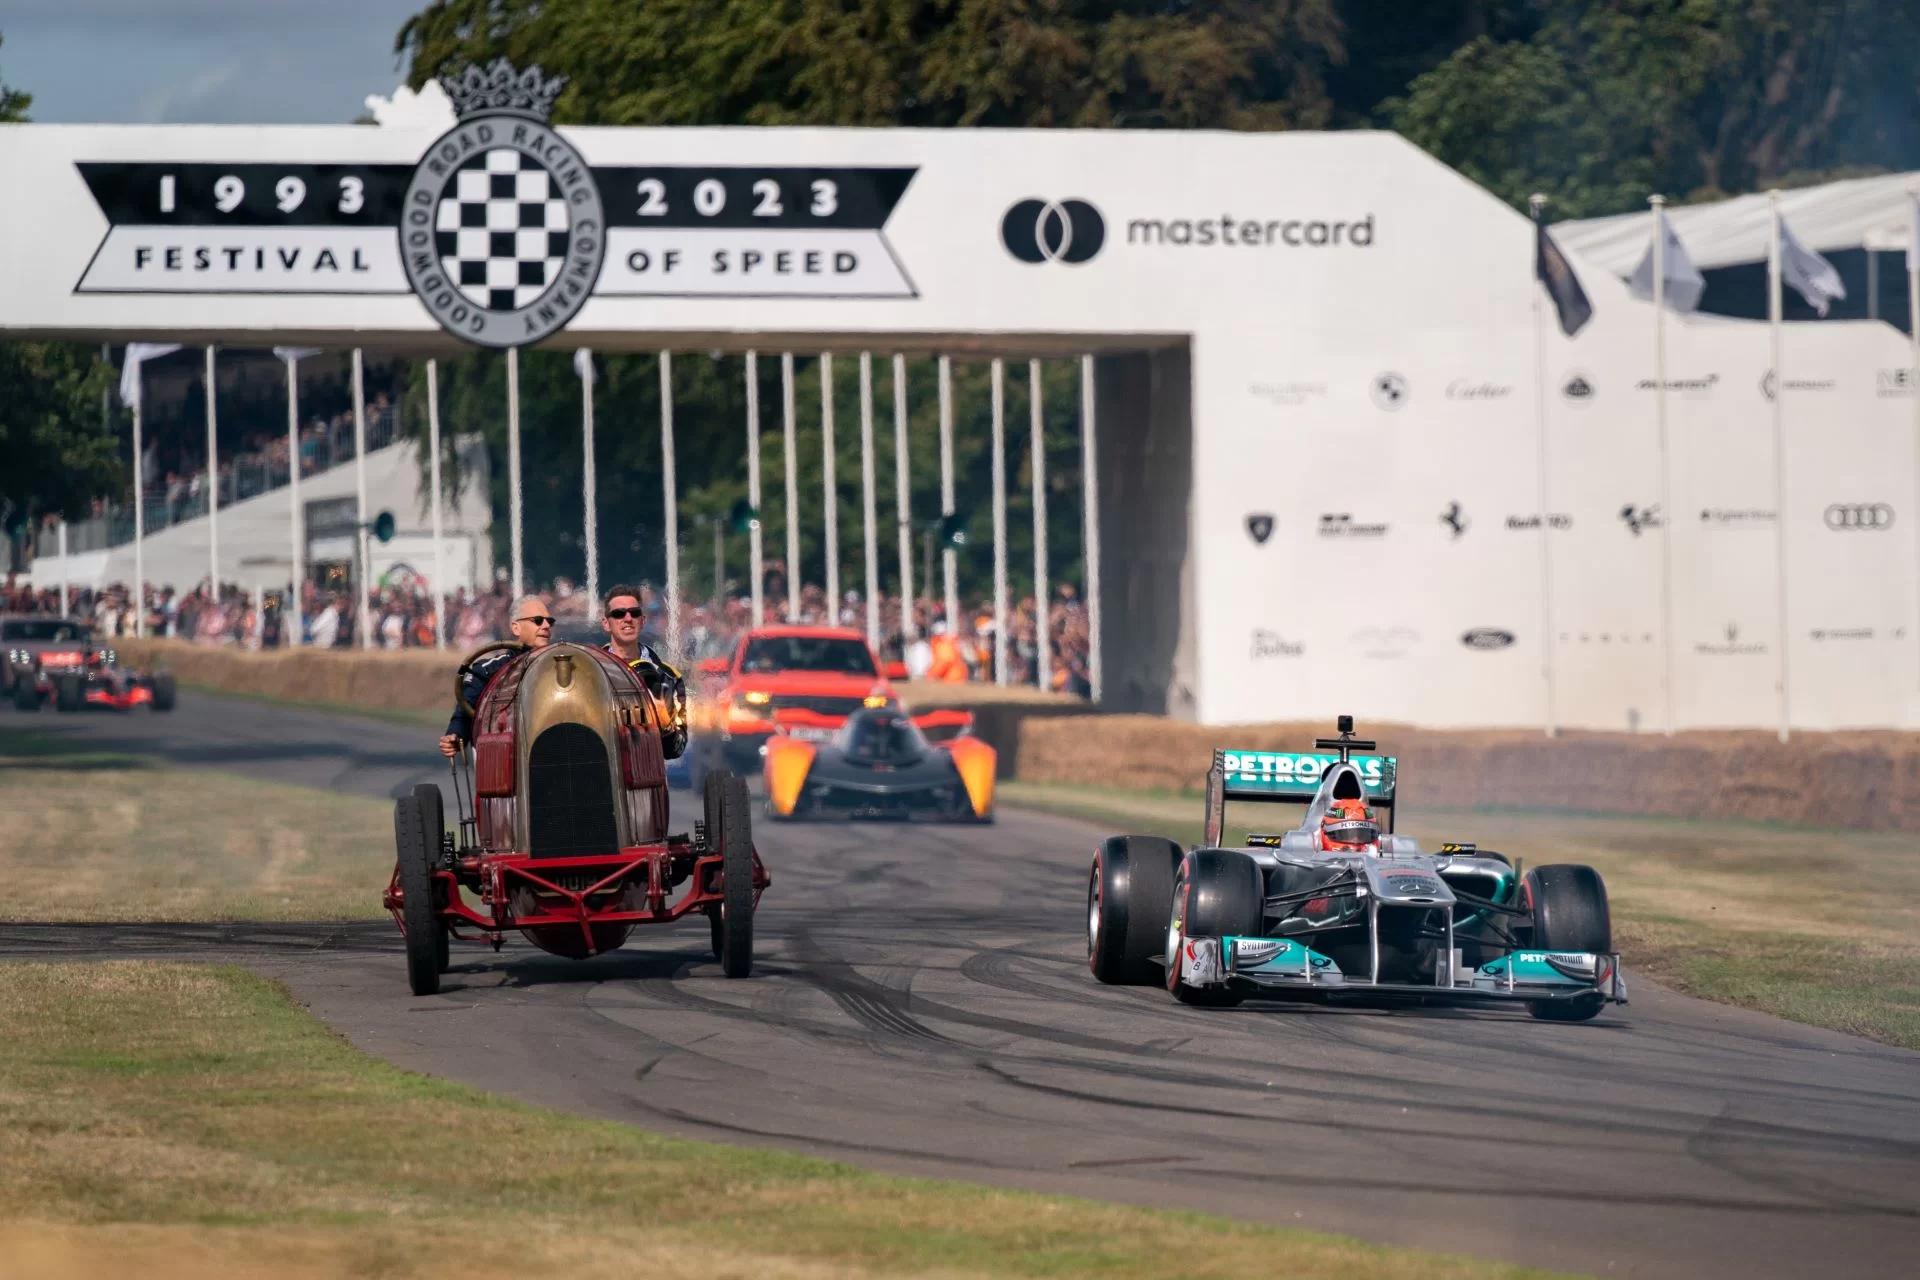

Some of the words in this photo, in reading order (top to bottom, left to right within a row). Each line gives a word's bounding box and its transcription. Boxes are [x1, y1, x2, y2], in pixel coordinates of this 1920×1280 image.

[428, 125, 494, 176] ROAD
[513, 124, 592, 206] RACING
[159, 175, 365, 214] 1993
[636, 178, 838, 217] 2023
[1127, 214, 1375, 247] mastercard
[134, 246, 370, 272] FESTIVAL
[627, 250, 681, 273] OF
[712, 250, 859, 274] SPEED
[409, 190, 486, 334] GOODWOOD
[523, 218, 597, 334] COMPANY
